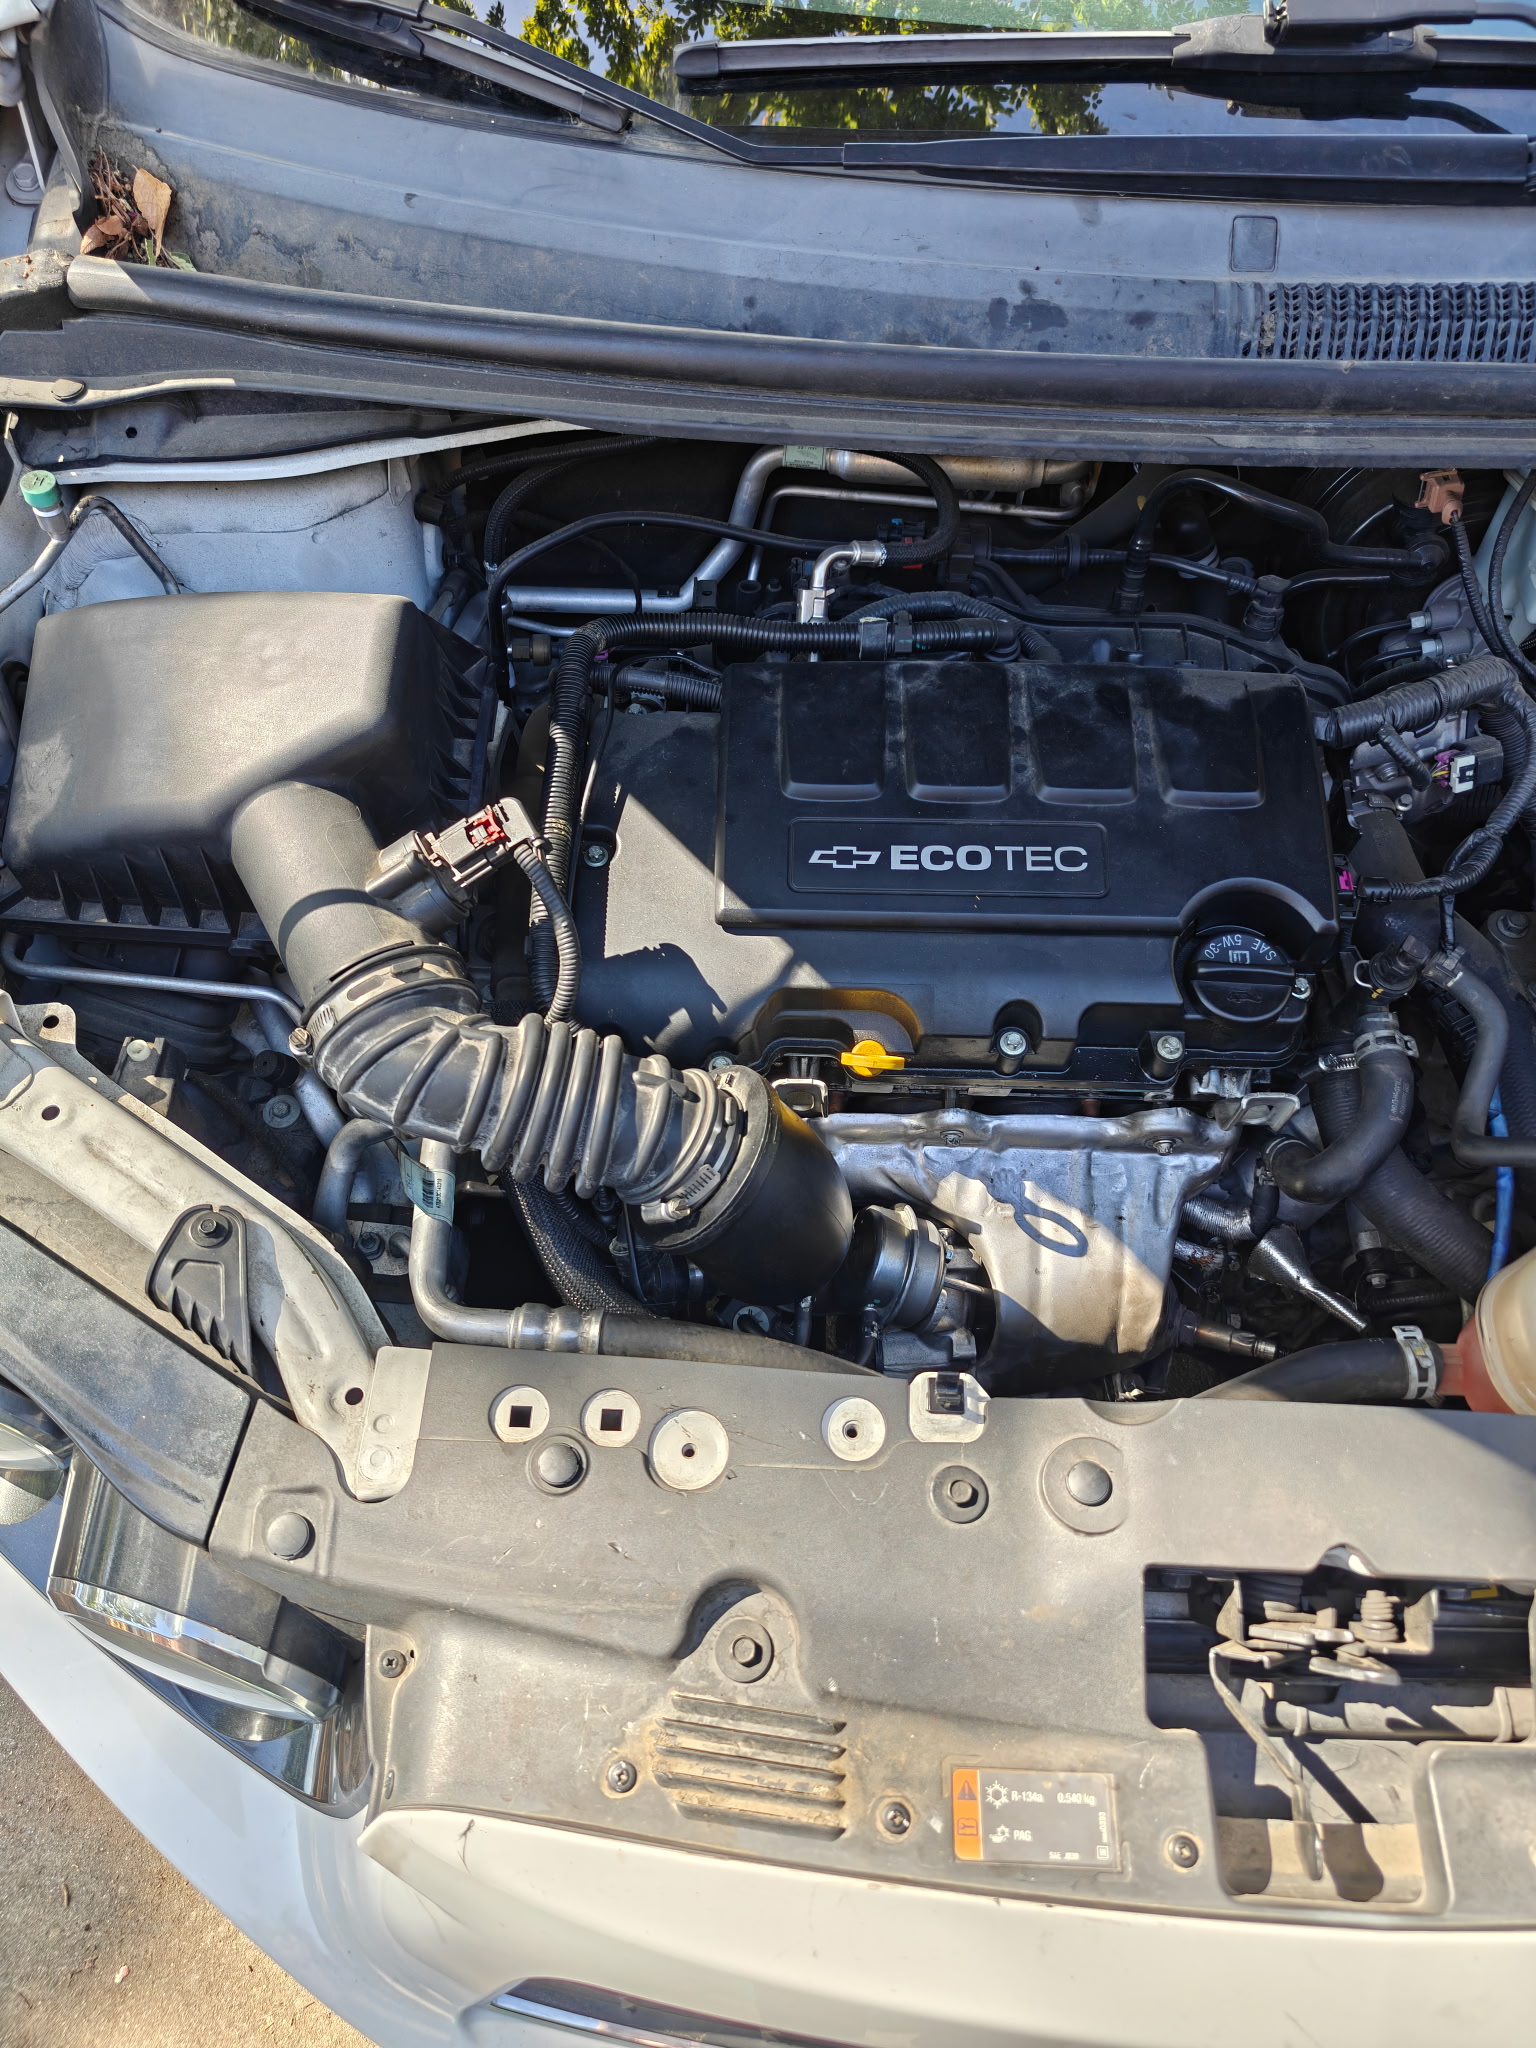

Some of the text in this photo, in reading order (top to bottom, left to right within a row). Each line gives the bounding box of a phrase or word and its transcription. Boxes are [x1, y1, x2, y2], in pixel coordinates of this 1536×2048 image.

[890, 844, 1089, 872] ECOTEC
[1204, 934, 1277, 961] SAE 5W-30
[1011, 1790, 1096, 1807] R-134a 0.540 kg
[1013, 1830, 1032, 1842] PAG
